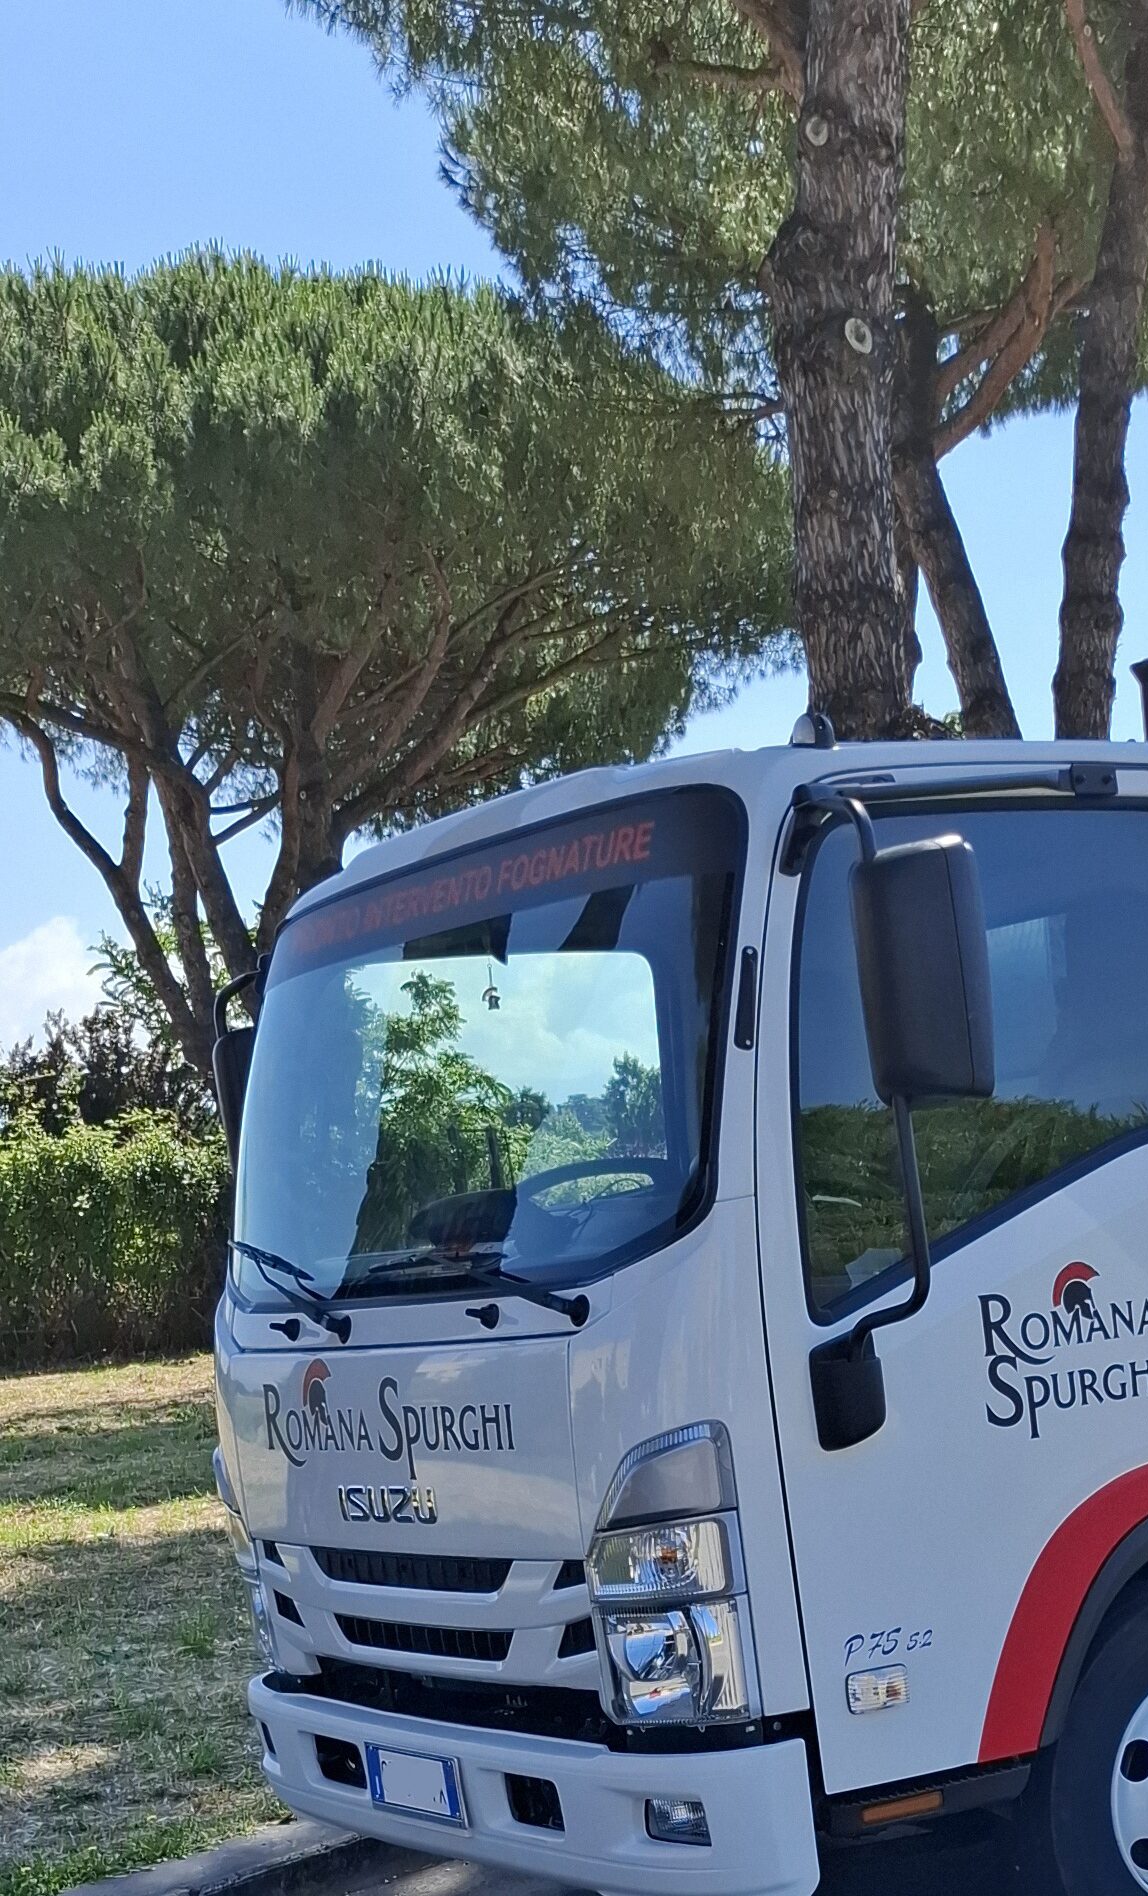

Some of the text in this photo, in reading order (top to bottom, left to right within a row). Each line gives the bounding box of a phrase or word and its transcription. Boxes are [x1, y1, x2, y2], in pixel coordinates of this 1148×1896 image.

[364, 865, 493, 931] INTERVENTO
[497, 821, 656, 893] FOGNATURE
[262, 1375, 516, 1480] ROMANA SPURGHI
[337, 1484, 439, 1525] ISUZU
